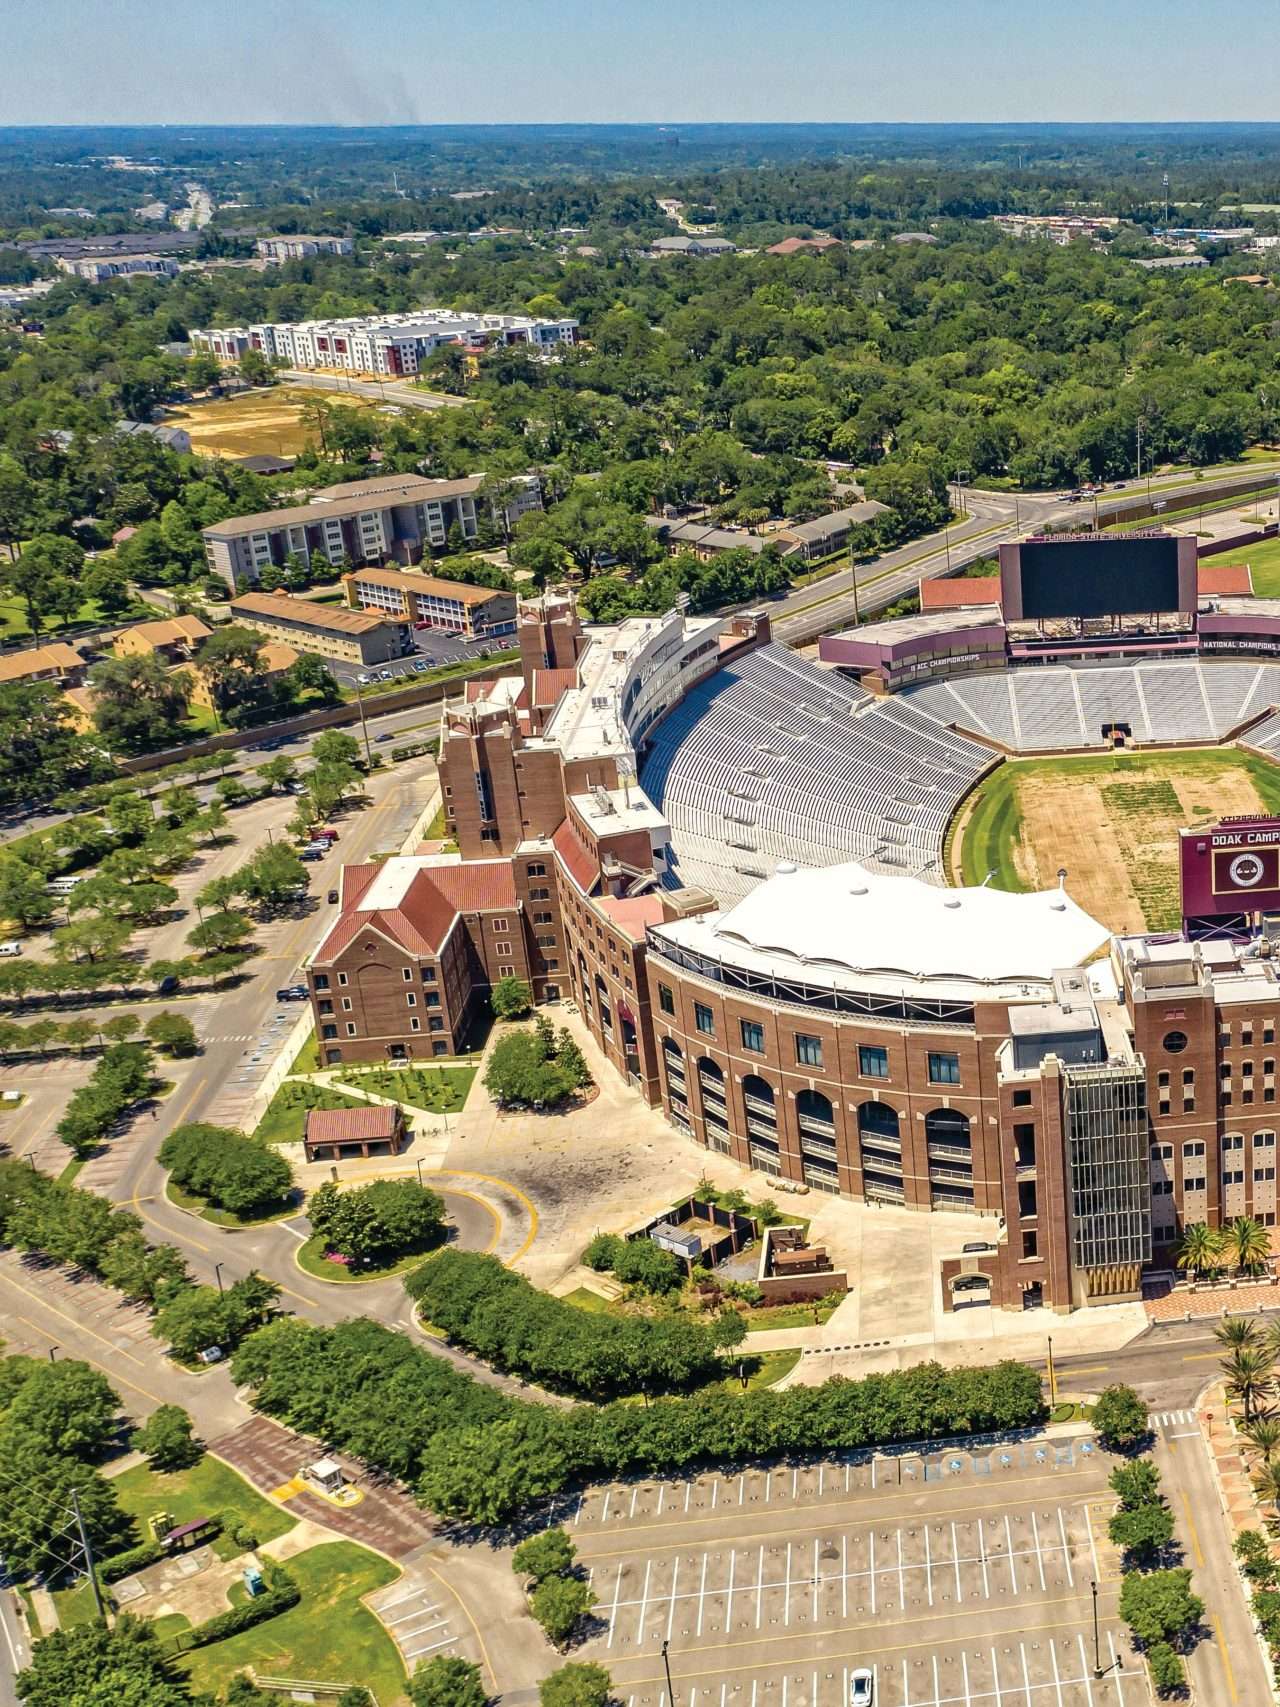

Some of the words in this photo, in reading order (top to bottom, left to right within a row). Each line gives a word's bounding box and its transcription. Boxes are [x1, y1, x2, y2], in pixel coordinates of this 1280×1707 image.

[1043, 533, 1077, 542] FLORIDA
[1081, 532, 1104, 540] STATE
[1112, 530, 1154, 539] UNIVERSITY
[1239, 641, 1276, 650] CHAMPIONS
[917, 662, 929, 670] ACC
[929, 654, 980, 667] CHAMPIONSHIPS
[1212, 835, 1242, 846] DOAK
